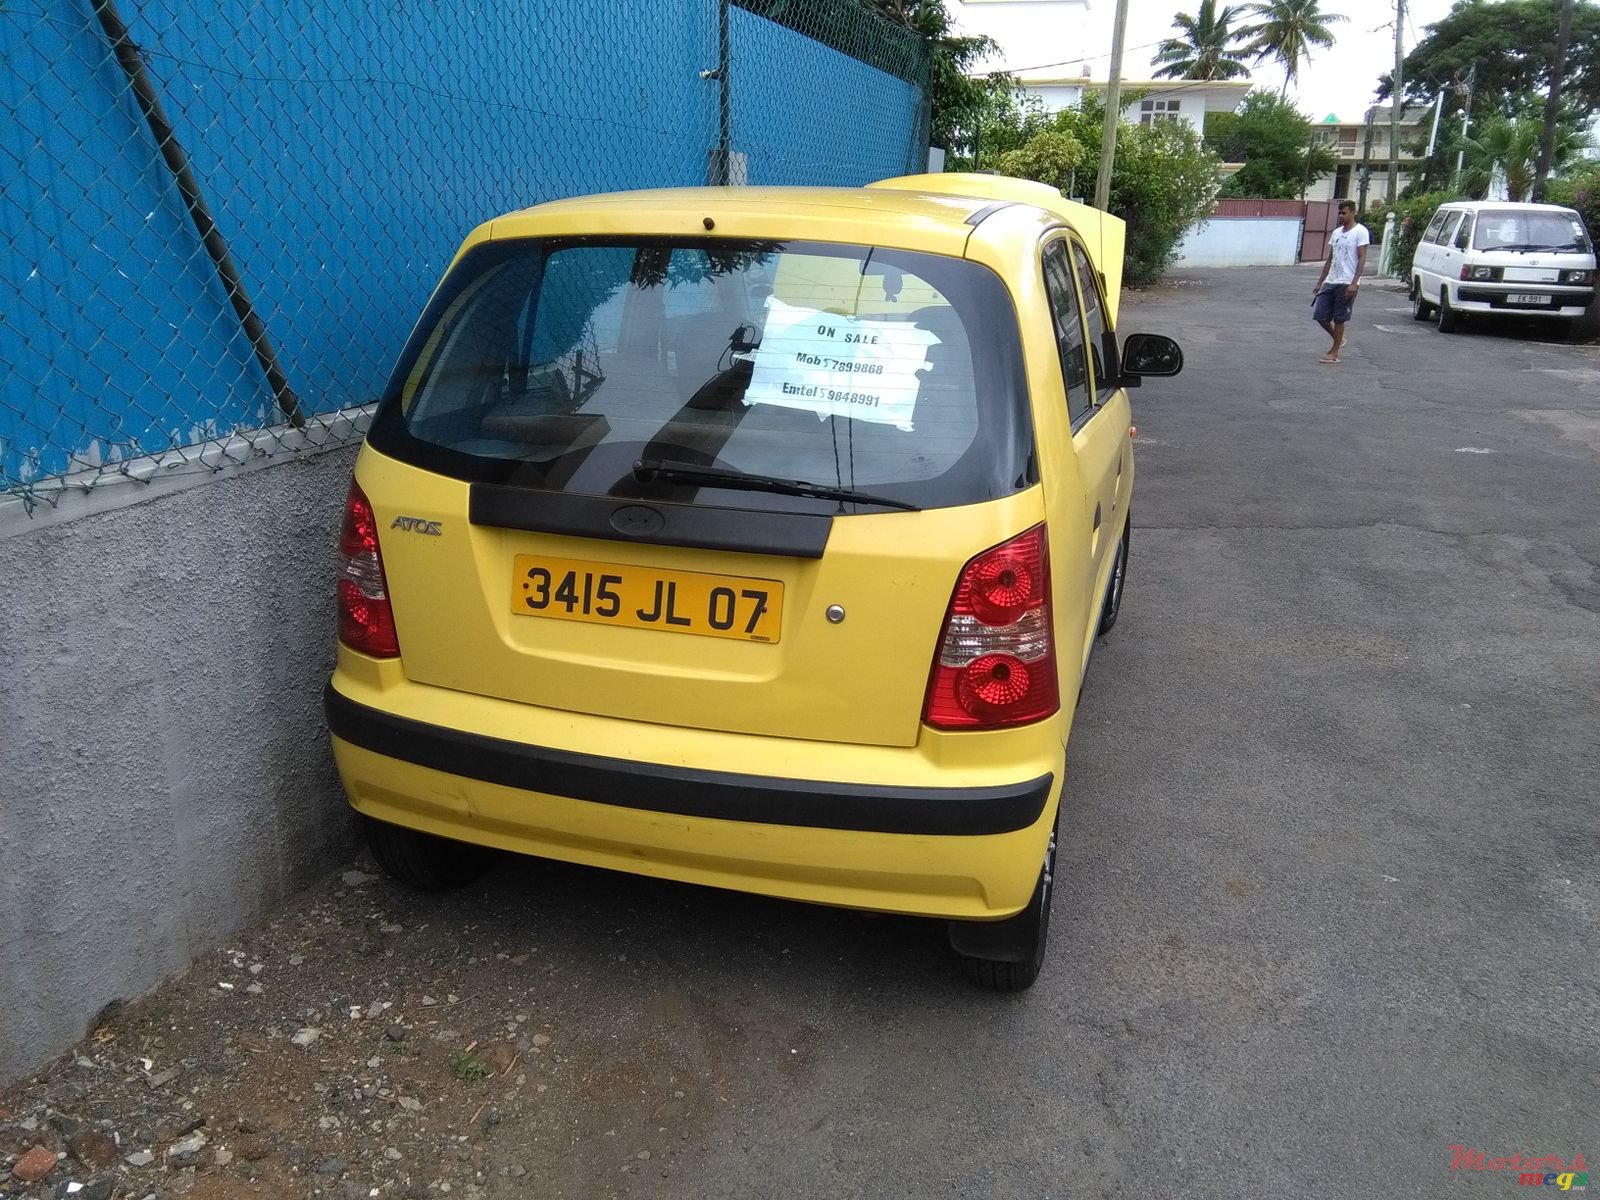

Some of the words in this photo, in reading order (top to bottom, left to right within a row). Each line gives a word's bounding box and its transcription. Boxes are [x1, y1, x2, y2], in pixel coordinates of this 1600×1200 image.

[817, 325, 836, 338] ON
[844, 333, 879, 345] SALE
[391, 515, 442, 536] ATOS
[525, 567, 622, 617] 3415
[636, 580, 691, 627] JL
[708, 586, 768, 633] 07
